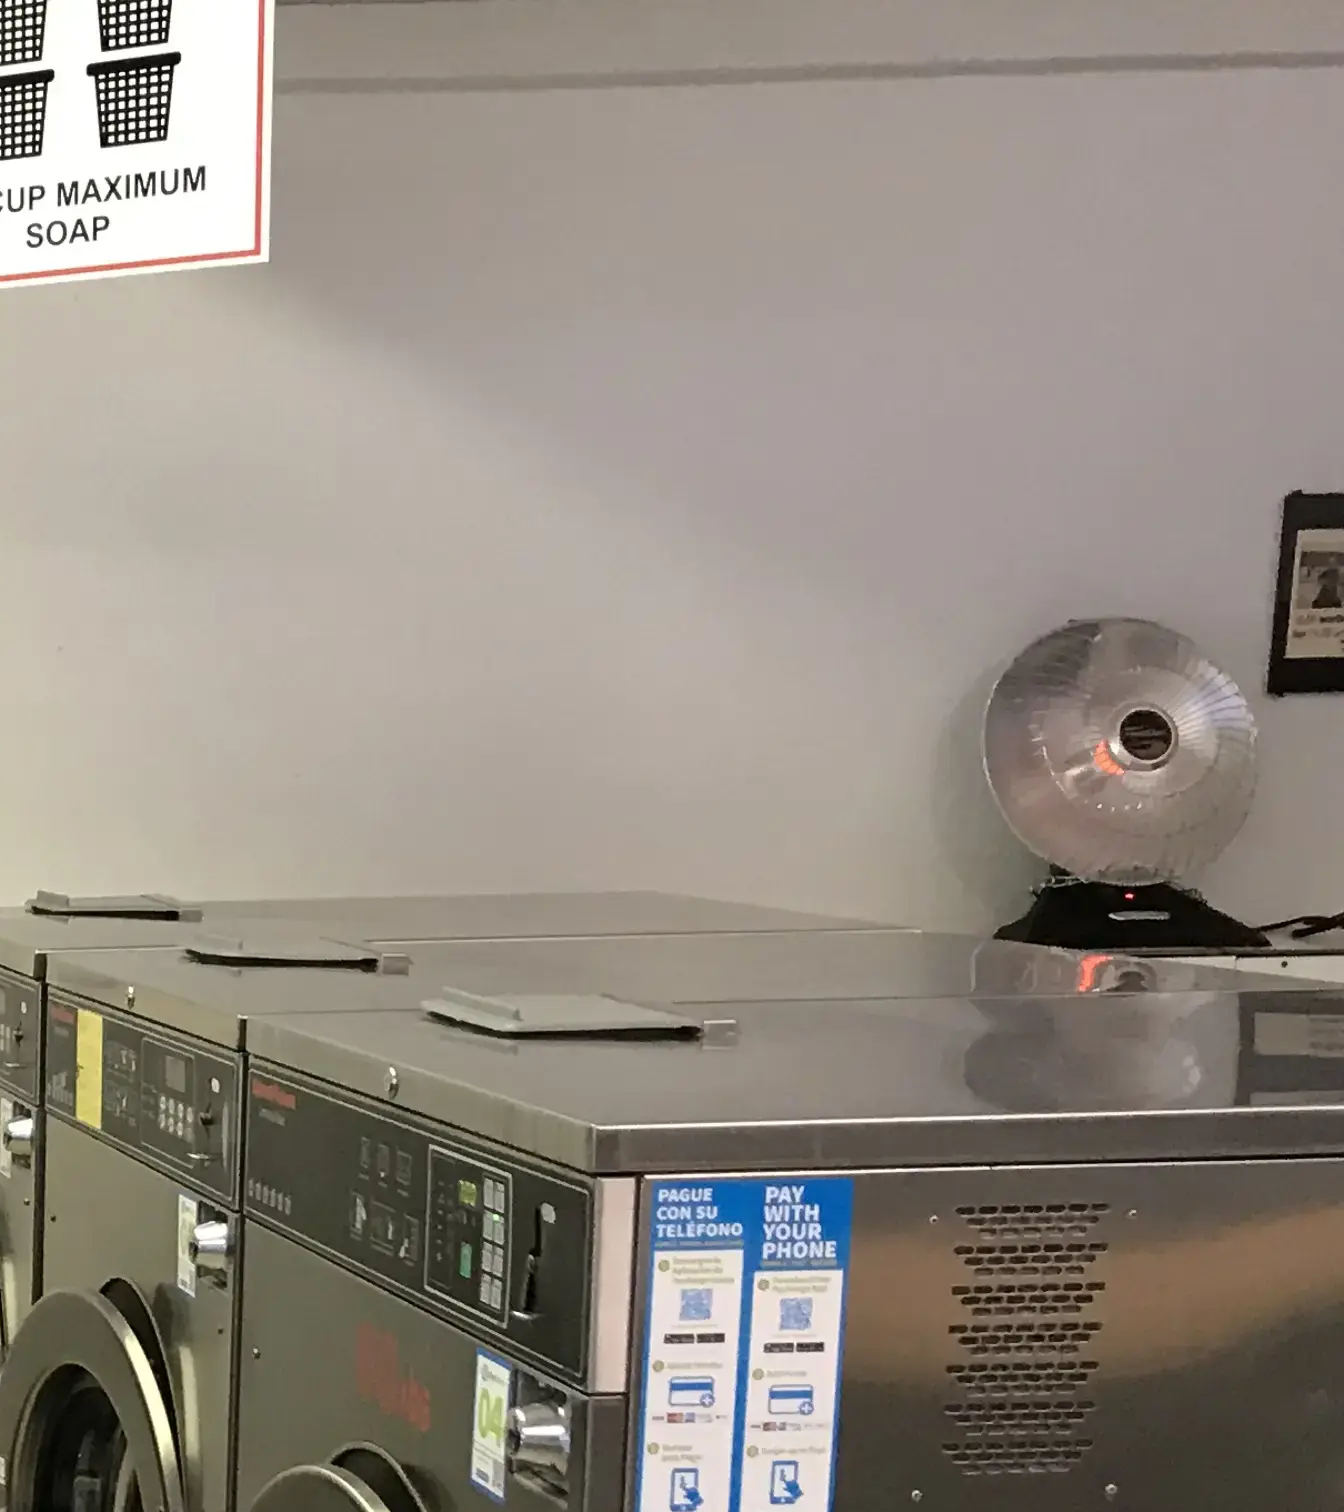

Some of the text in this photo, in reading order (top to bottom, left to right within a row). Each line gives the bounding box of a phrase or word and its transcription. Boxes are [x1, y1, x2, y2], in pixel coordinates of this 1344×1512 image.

[57, 165, 207, 207] MAXIMUM
[26, 216, 110, 248] SOAP
[658, 1188, 713, 1203] PAGUE
[765, 1185, 805, 1204] PAY
[656, 1205, 718, 1221] CON SU
[763, 1204, 820, 1223] WITH
[763, 1222, 822, 1241] YOUR
[762, 1240, 837, 1260] PHONE
